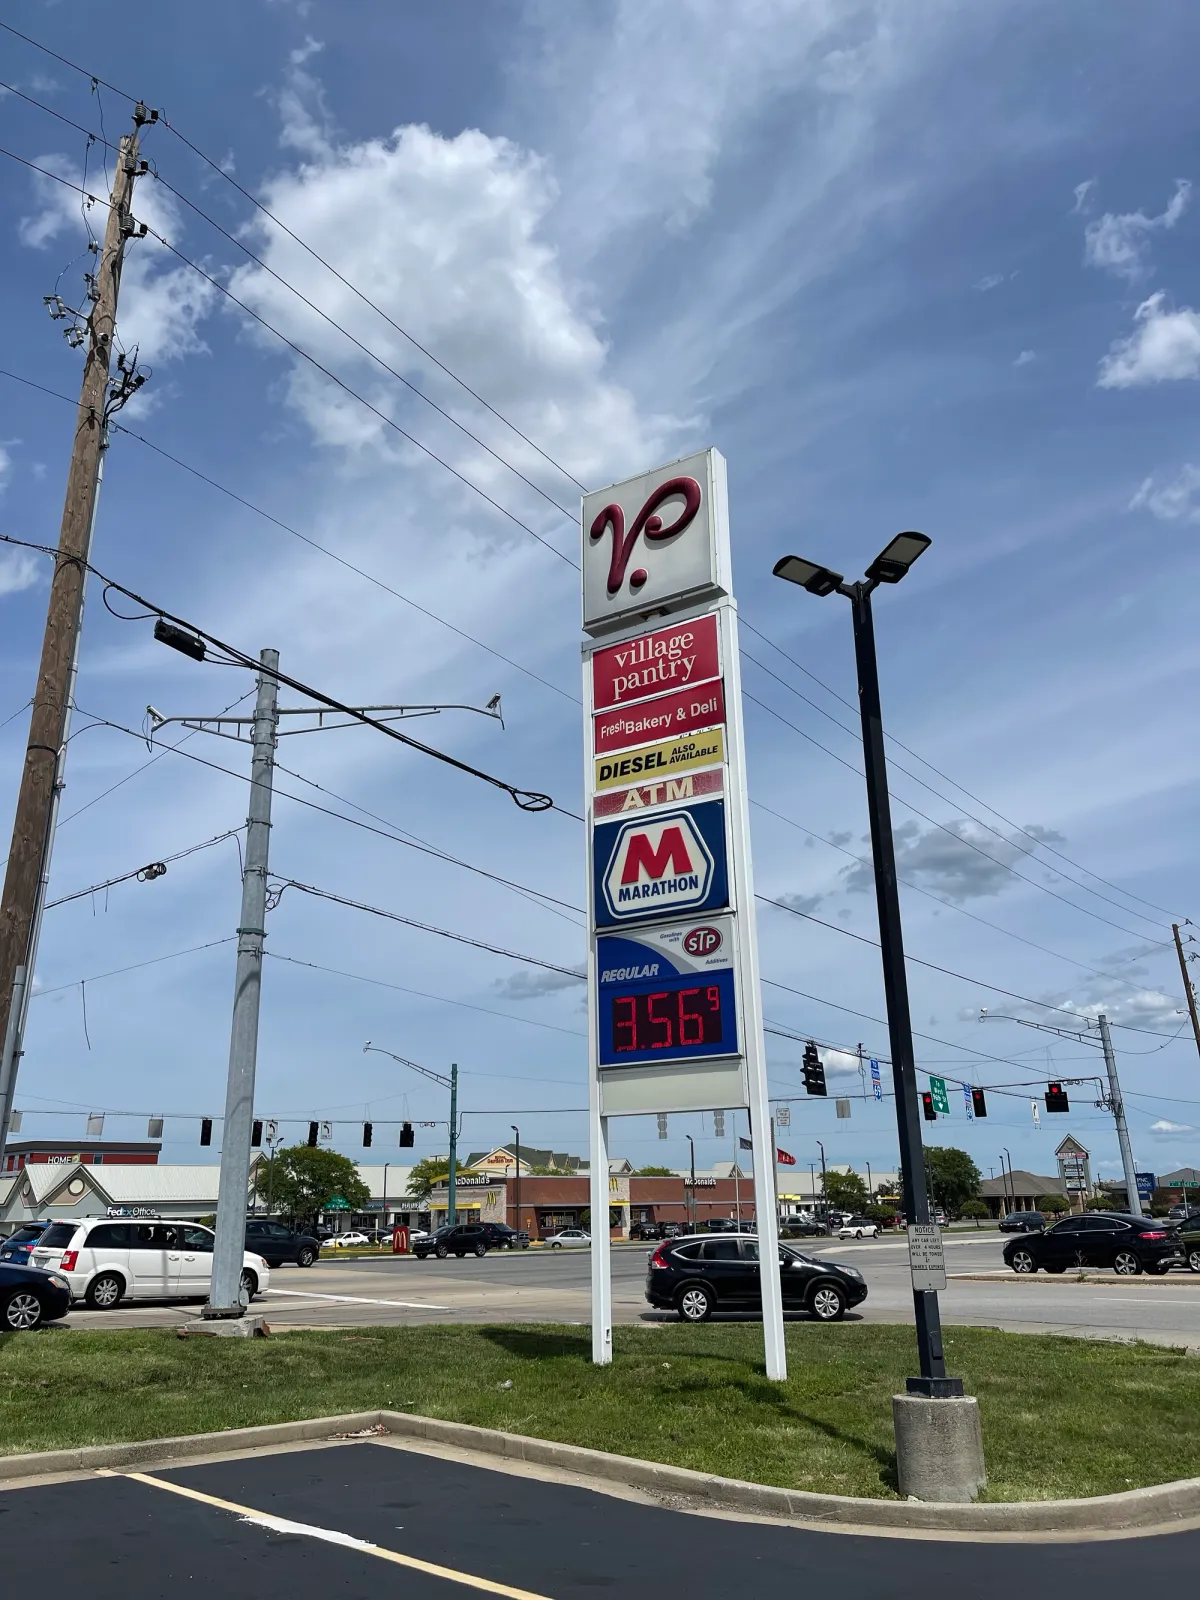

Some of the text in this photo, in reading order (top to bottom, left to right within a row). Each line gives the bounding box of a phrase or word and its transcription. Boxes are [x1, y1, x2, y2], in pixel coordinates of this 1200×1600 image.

[614, 632, 694, 668] village
[612, 655, 697, 702] pantry
[601, 698, 717, 739] Fresh Bakery & Deli
[669, 745, 718, 765] AVAILABLE
[671, 743, 696, 755] ALSO
[600, 751, 667, 781] DIESEL
[621, 776, 694, 812] ATM
[618, 875, 699, 902] MARATHON
[688, 930, 716, 951] STP
[600, 963, 659, 983] REGULAR
[107, 1206, 156, 1216] FedEx Office
[914, 1226, 935, 1234] NOTICE
